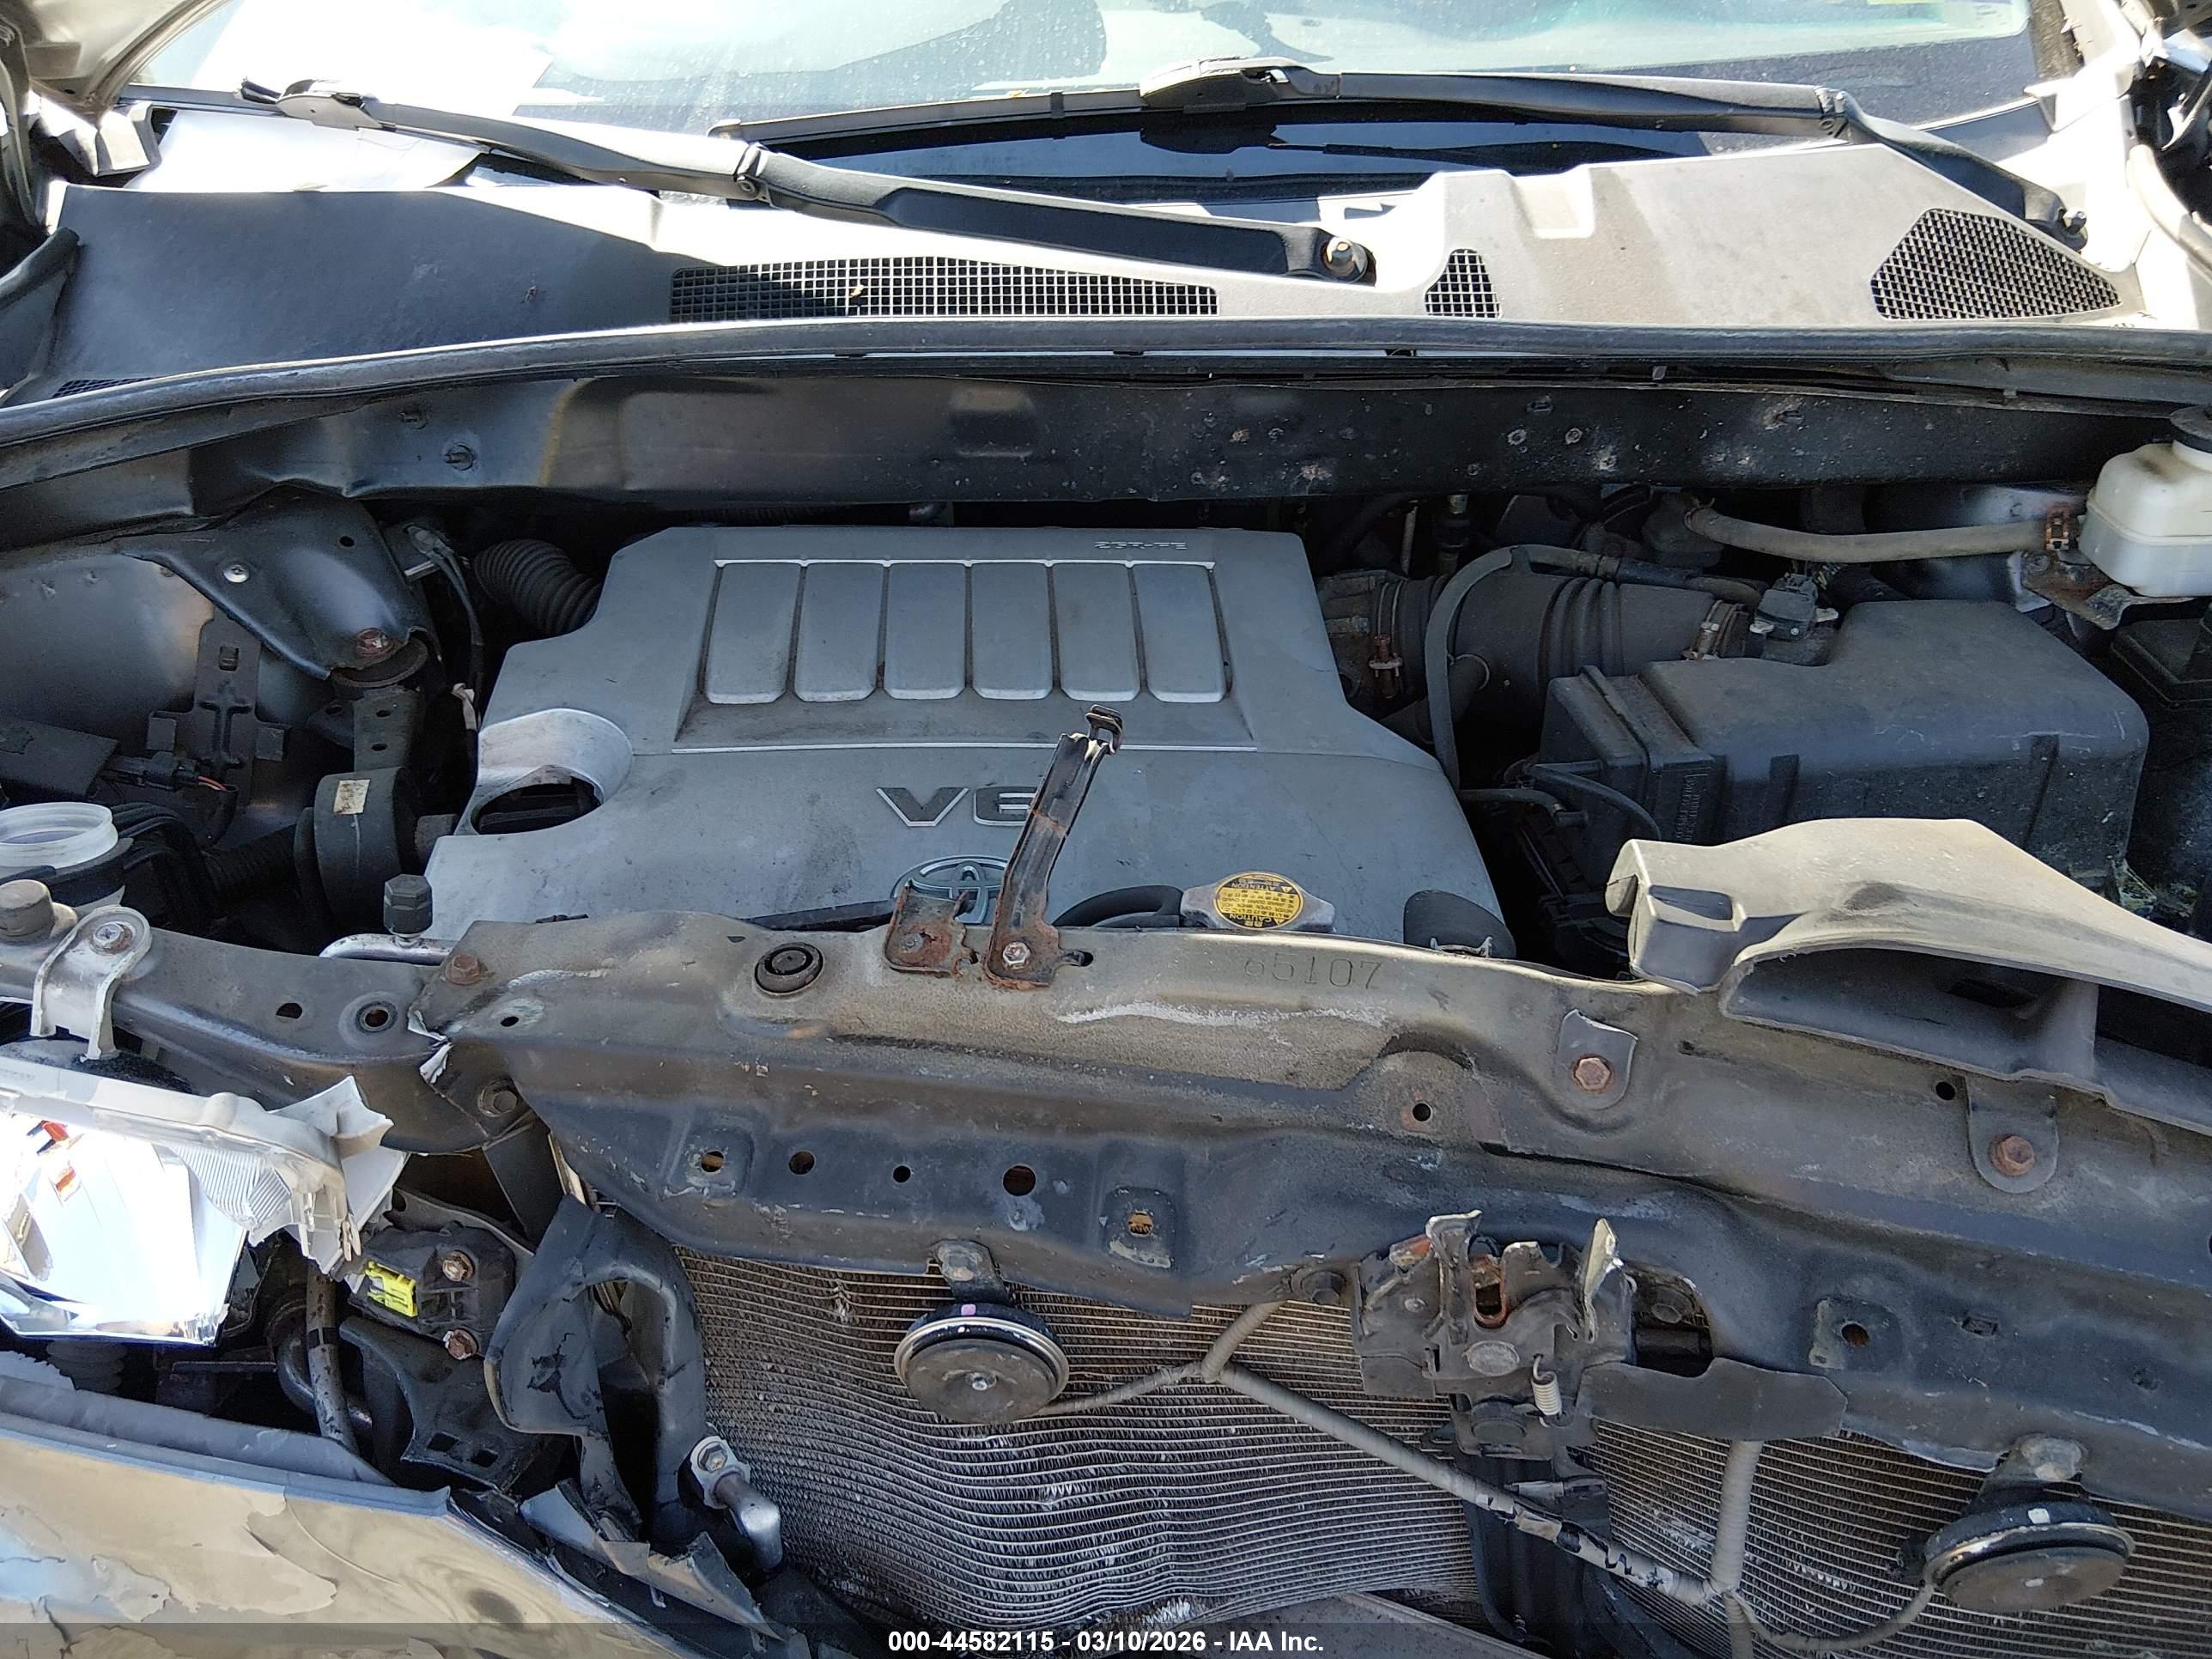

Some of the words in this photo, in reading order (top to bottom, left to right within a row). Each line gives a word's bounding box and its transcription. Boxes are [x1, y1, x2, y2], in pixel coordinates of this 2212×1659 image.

[876, 786, 1037, 827] V6
[1231, 882, 1276, 891] ATTENTION
[1229, 913, 1272, 923] CAUTION
